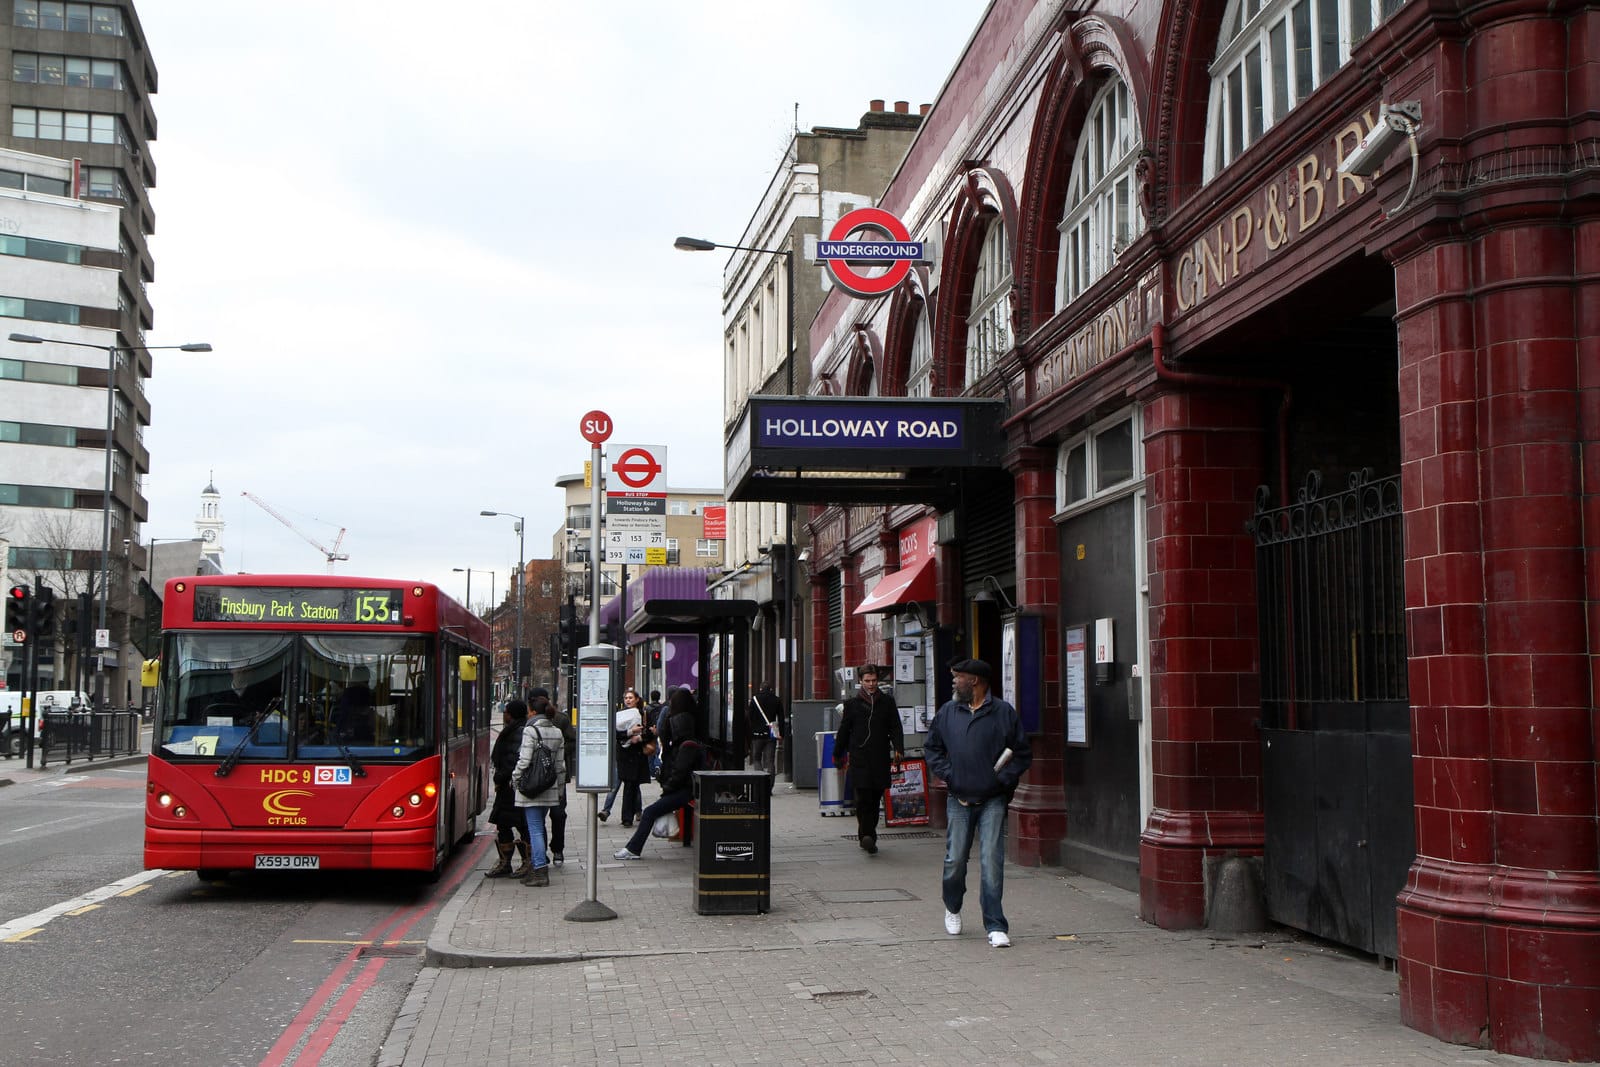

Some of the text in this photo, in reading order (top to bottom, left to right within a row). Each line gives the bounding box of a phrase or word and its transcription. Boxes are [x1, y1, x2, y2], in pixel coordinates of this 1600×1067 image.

[821, 244, 919, 256] UNDERGROUND
[585, 420, 608, 435] SU
[765, 418, 958, 438] HOLLOWAY ROAD
[609, 551, 623, 559] 393
[220, 596, 389, 621] Finsbury Park Station 153
[260, 769, 312, 784] HDC 9
[267, 817, 308, 825] CT PLUS
[257, 856, 291, 868] X593
